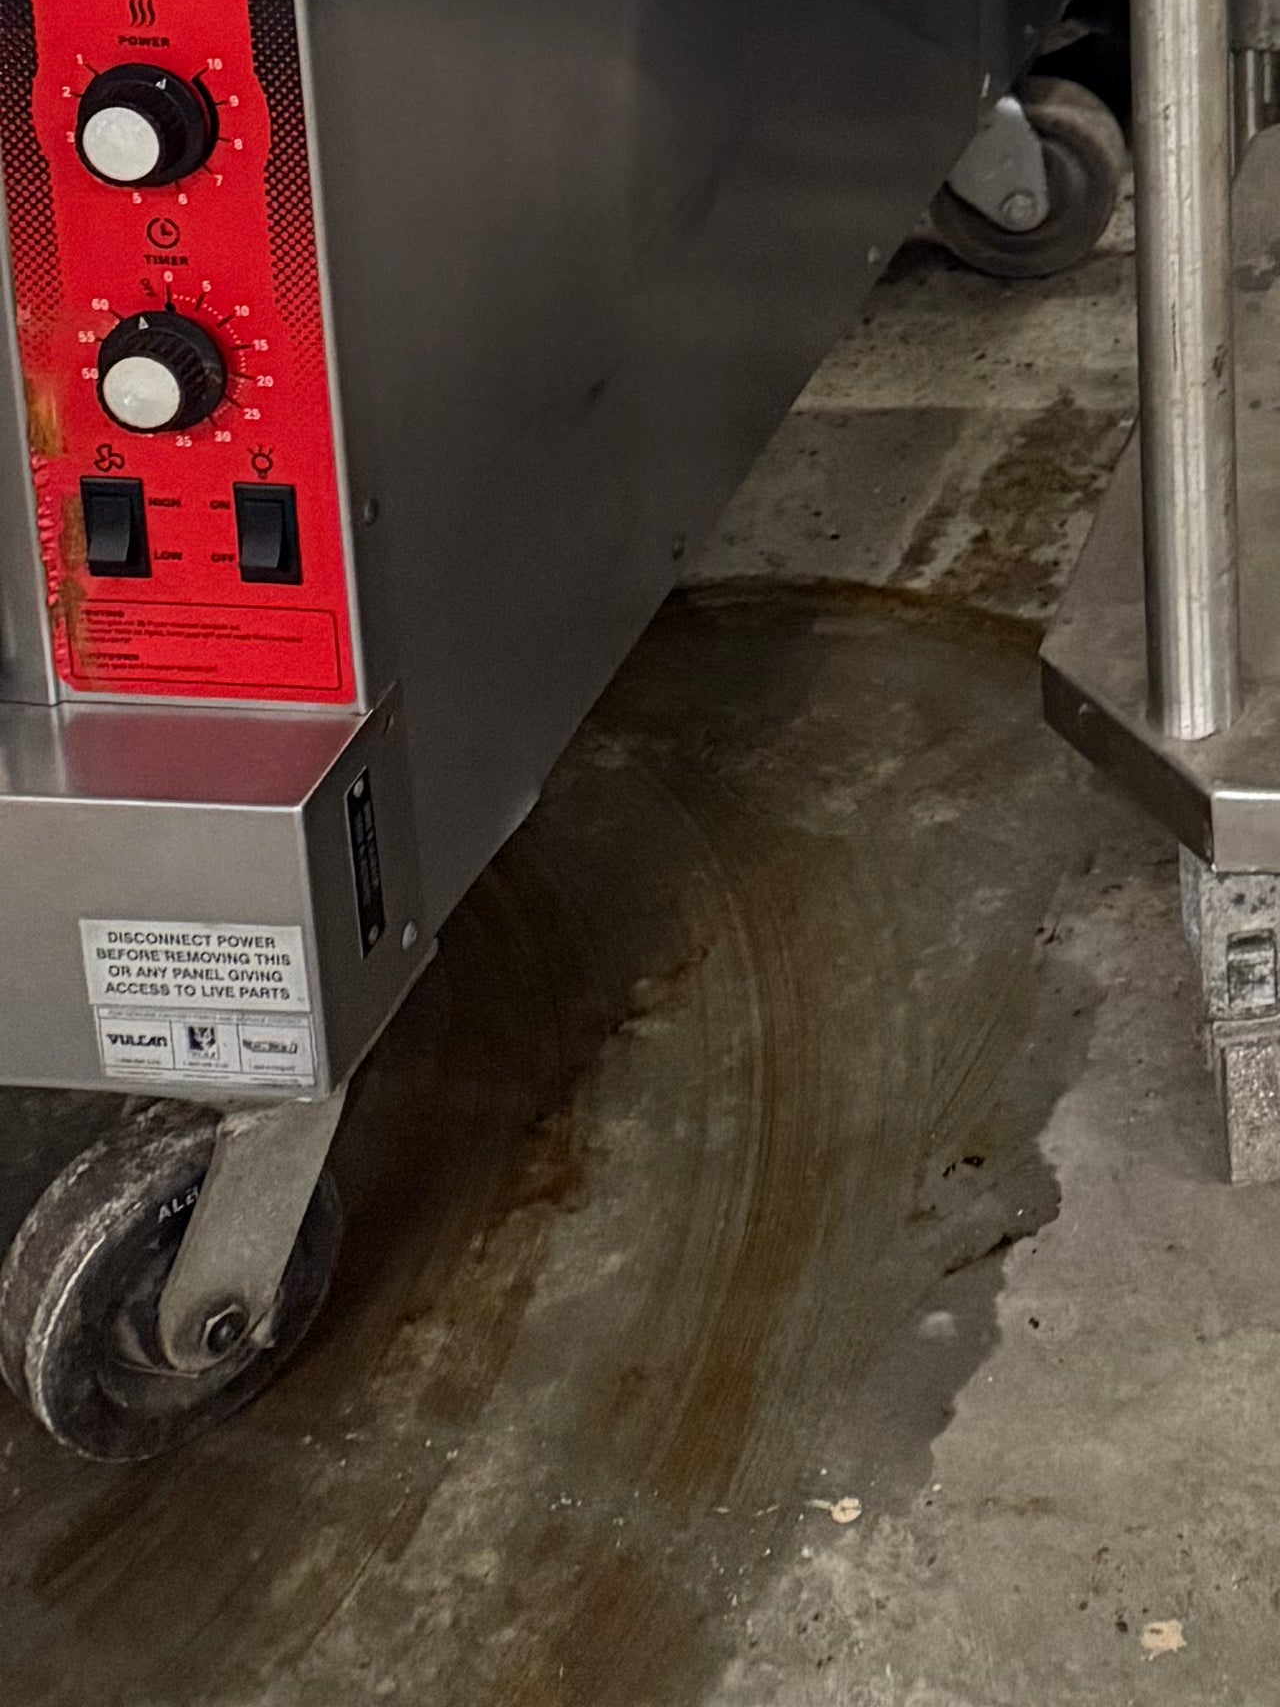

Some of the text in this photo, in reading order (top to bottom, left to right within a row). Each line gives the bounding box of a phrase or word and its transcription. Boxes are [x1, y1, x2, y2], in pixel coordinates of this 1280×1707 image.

[118, 35, 171, 47] POWER
[76, 54, 83, 65] 1
[206, 58, 223, 70] 10
[62, 86, 71, 97] 2
[214, 175, 224, 187] 7
[132, 193, 142, 204] 5
[163, 271, 173, 282] 0
[203, 281, 211, 292] 5
[234, 305, 249, 317] 10
[253, 339, 269, 351] 15
[257, 376, 273, 387] 20
[107, 931, 276, 948] DISCONNECT POWER
[96, 947, 291, 966] BEFORE REMOVING THIS
[108, 965, 283, 982] OR ANY PANEL GIVING
[105, 982, 290, 1000] ACCESS TO LIVE PARTS
[105, 1033, 168, 1047] VULCAN
